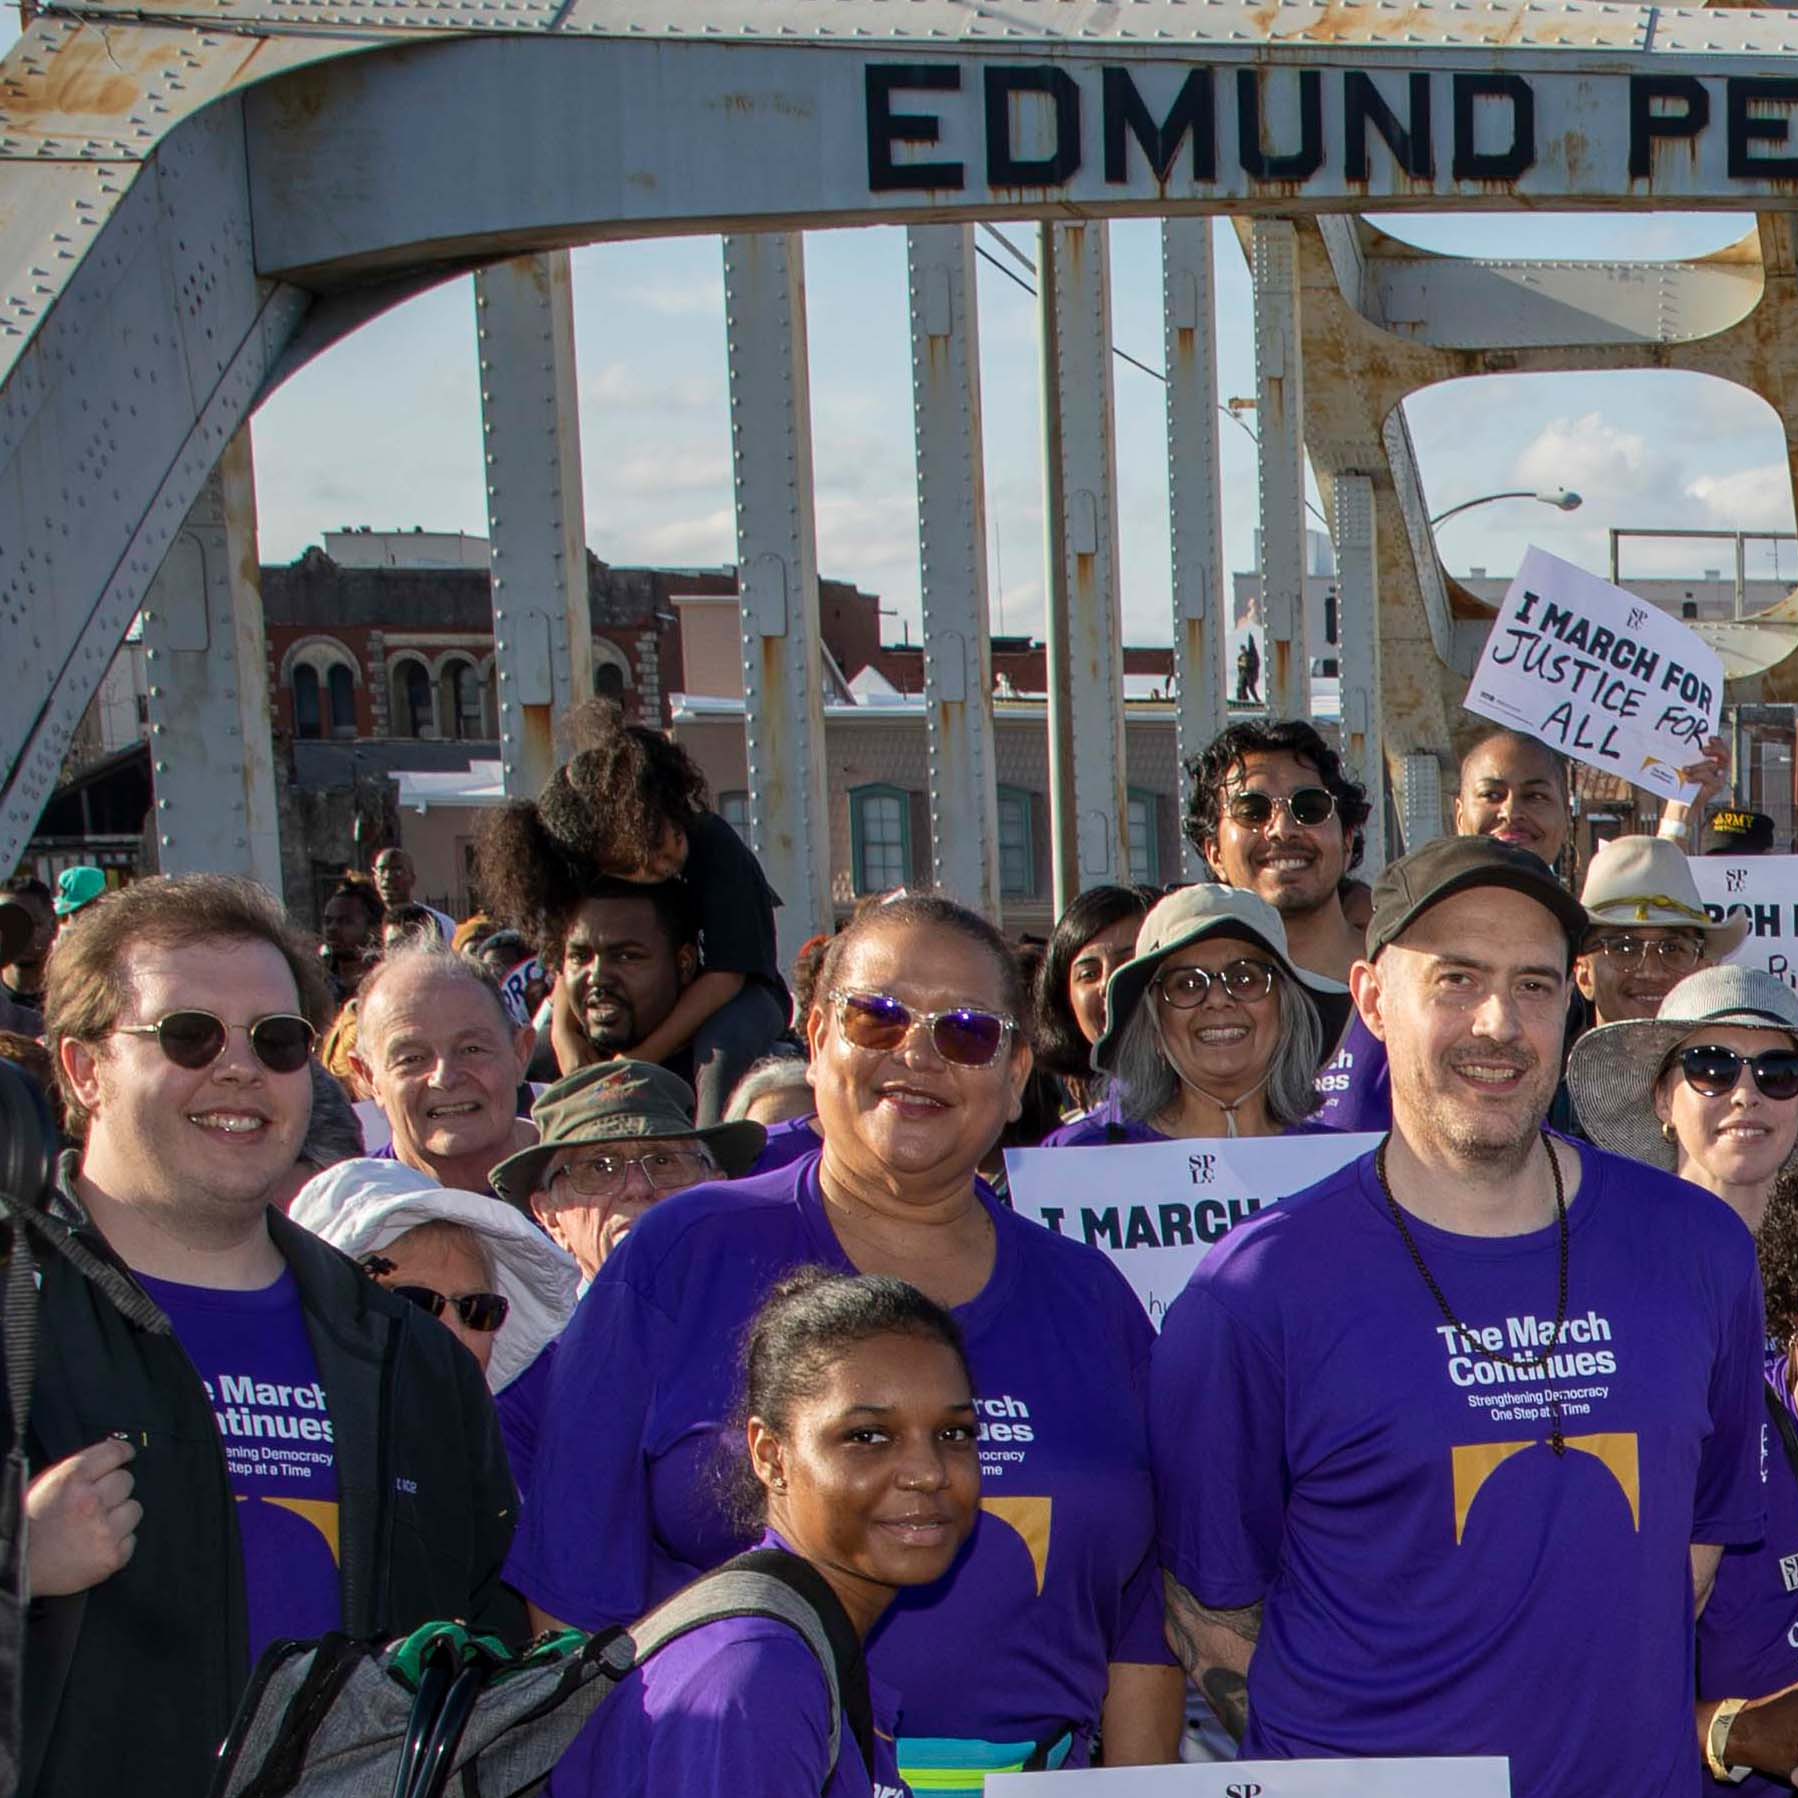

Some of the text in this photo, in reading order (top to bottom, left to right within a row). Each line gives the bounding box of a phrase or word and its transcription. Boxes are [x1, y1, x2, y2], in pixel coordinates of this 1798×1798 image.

[863, 63, 1535, 192] EDMUND
[1515, 591, 1714, 715] I MARCH FOR
[1491, 628, 1710, 751] JUSTICE FOR
[1540, 702, 1621, 759] ALL
[1436, 1310, 1613, 1355] The March
[1448, 1349, 1617, 1386] Continues
[1468, 1390, 1544, 1408] Strengthening
[1491, 1402, 1591, 1422] One Step Time
[263, 1447, 334, 1467] Democracy
[281, 1465, 312, 1477] Time
